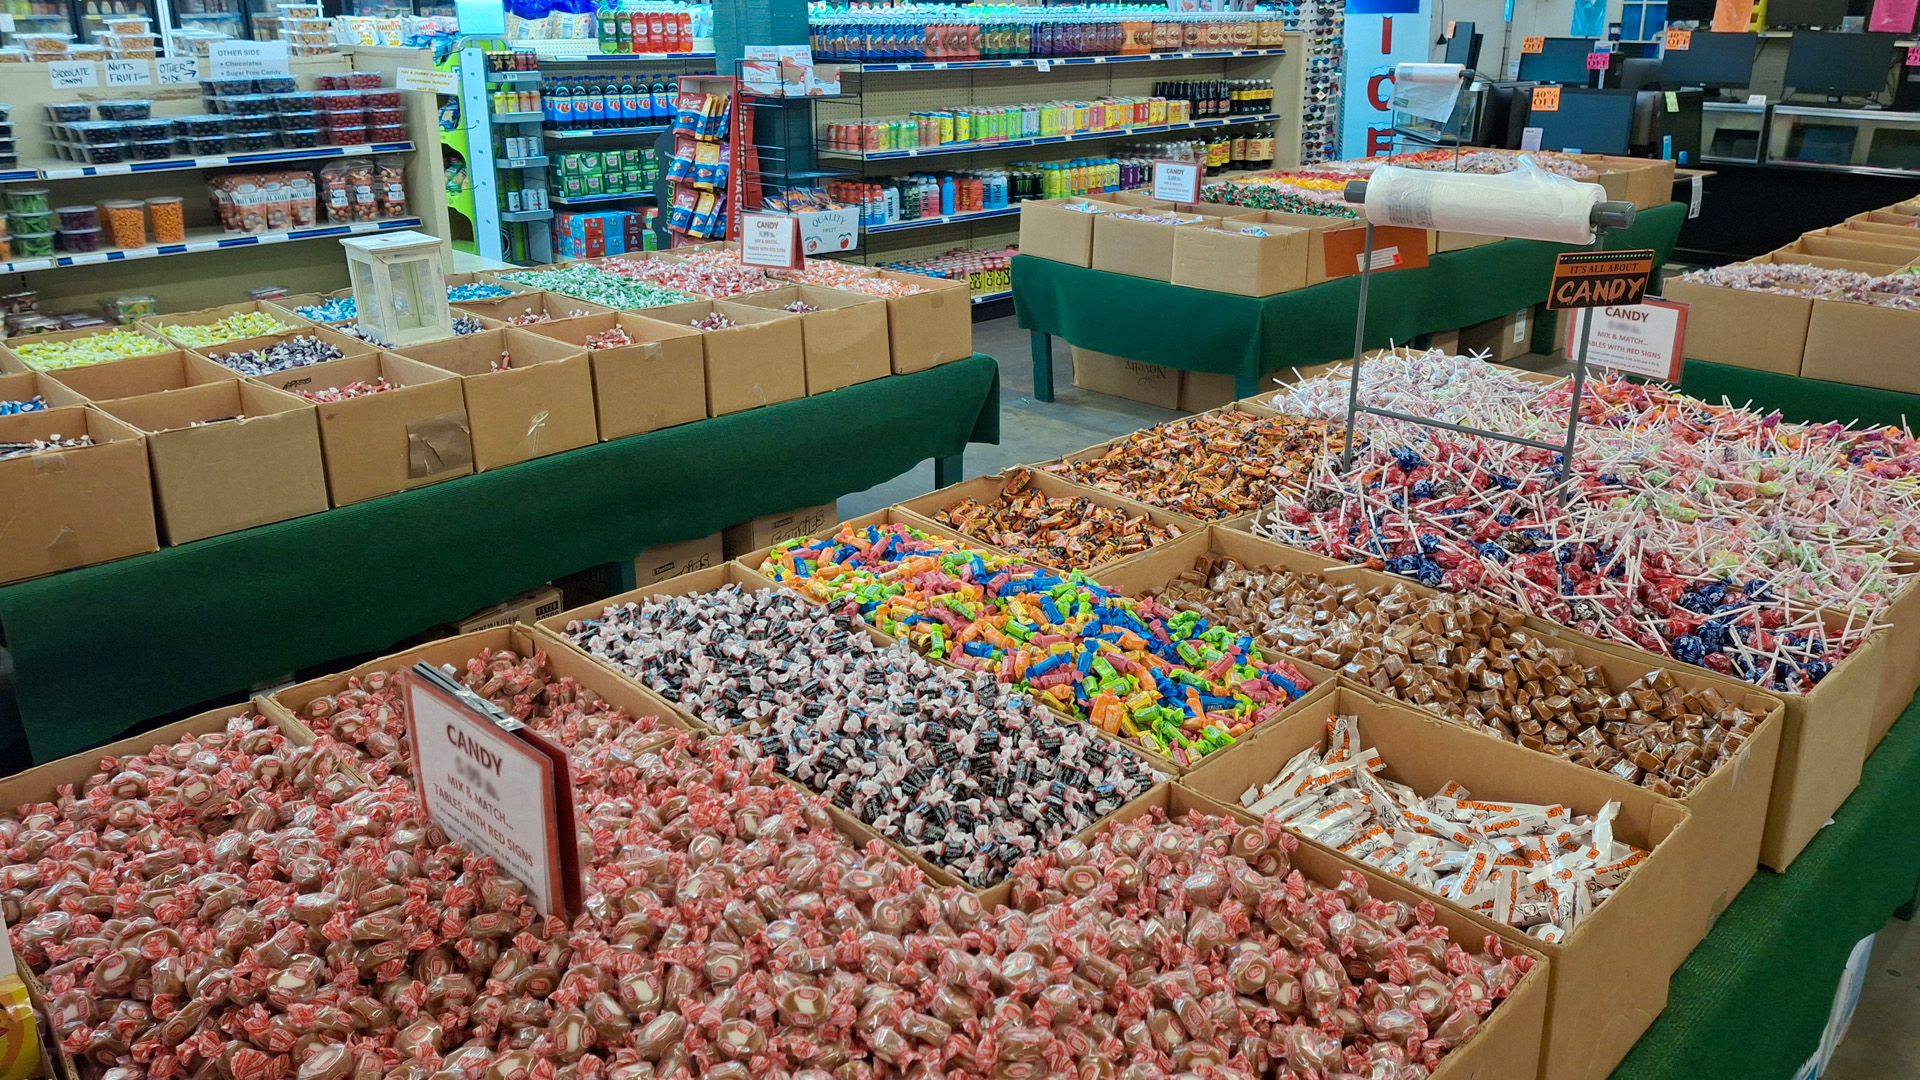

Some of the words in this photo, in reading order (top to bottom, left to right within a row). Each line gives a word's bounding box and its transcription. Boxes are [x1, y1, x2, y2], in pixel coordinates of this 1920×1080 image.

[1669, 31, 1689, 39] 40%
[1667, 39, 1688, 47] OFF
[108, 62, 134, 71] NUTS
[159, 63, 186, 74] OTHER
[51, 67, 90, 79] CHOCOLATE
[109, 72, 138, 83] FRUIT
[161, 73, 182, 83] SIDE
[226, 70, 248, 78] Sugar
[265, 68, 281, 76] Candy
[60, 76, 83, 85] CANDY
[1534, 90, 1558, 99] 40%
[1533, 98, 1558, 107] OFF
[733, 168, 744, 232] SNACKING
[756, 220, 779, 230] CANDY
[812, 213, 846, 228] QUALITY
[1588, 263, 1606, 273] ALL
[1608, 263, 1638, 272] ABOUT
[1556, 278, 1645, 305] CANDY
[1605, 306, 1650, 323] CANDY
[1597, 331, 1611, 339] MIX
[1588, 340, 1606, 349] ABLES
[1607, 344, 1625, 353] WITH
[1626, 347, 1641, 356] RED
[1641, 350, 1661, 360] SIGNS
[1125, 359, 1167, 379] Novelty
[446, 724, 503, 776] CANDY
[447, 773, 464, 793] MIX
[466, 786, 474, 800] &
[433, 783, 463, 813] TABLES
[464, 805, 487, 832] WITH
[487, 824, 506, 845] RED
[507, 838, 534, 867] SIGNS
